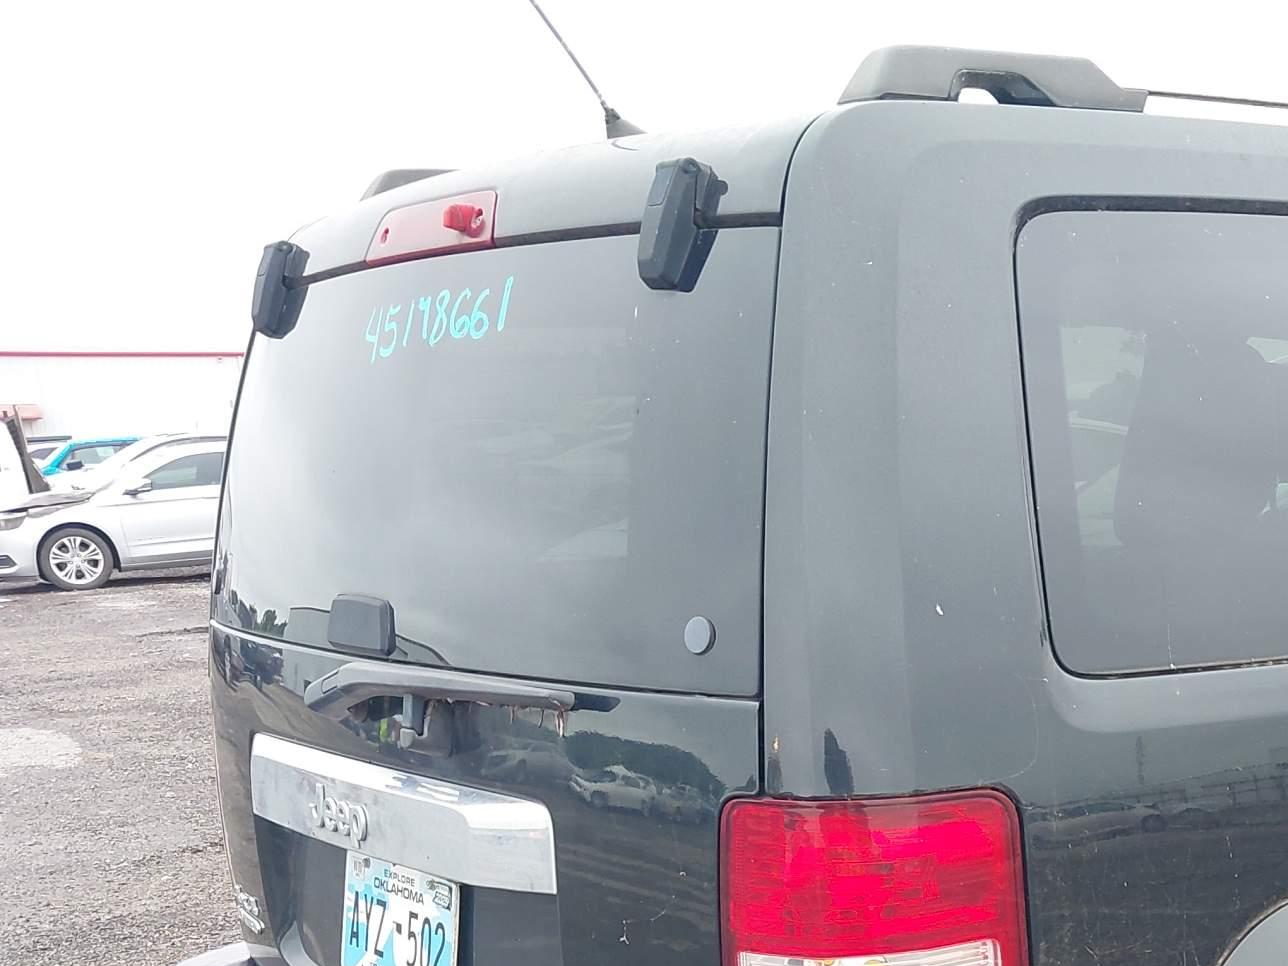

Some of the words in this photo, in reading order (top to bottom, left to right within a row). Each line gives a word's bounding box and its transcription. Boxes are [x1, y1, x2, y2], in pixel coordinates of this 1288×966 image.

[308, 783, 369, 849] Jeep
[373, 876, 425, 905] OKLAHOMA
[383, 868, 416, 887] EXPLORE
